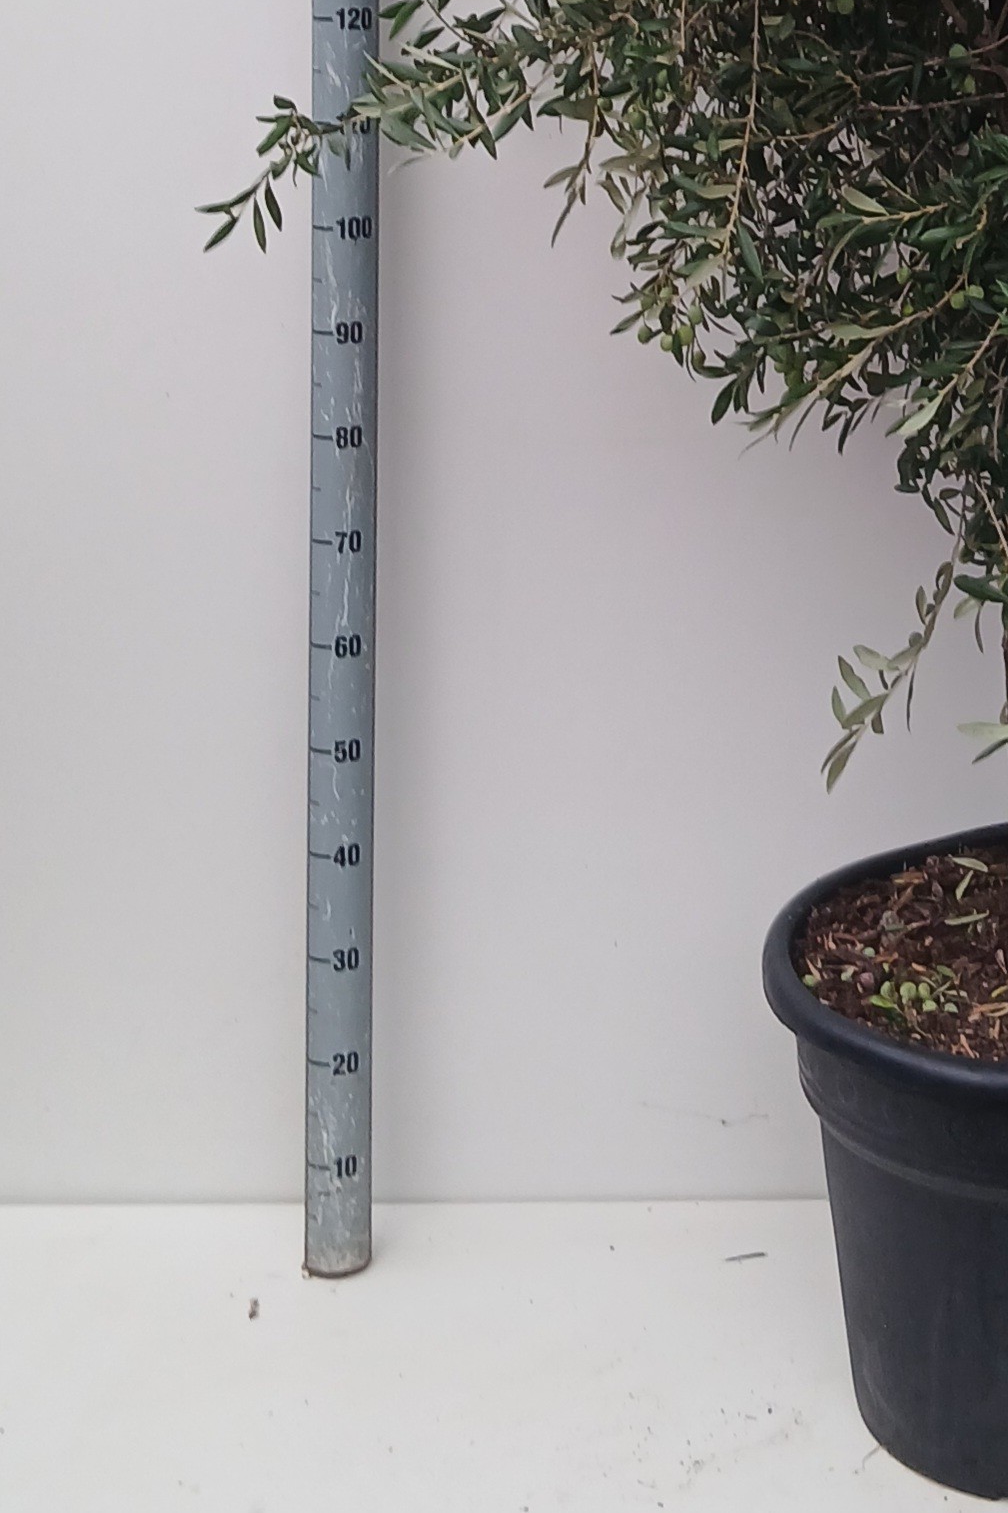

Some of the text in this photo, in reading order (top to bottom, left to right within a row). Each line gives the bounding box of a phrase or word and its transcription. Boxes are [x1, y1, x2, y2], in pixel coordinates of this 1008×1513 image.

[336, 7, 372, 30] 120
[336, 215, 372, 240] 100
[336, 321, 363, 345] 90
[336, 425, 363, 449] 80
[335, 529, 362, 554] 70
[334, 634, 362, 658] 60
[334, 739, 361, 763] 50
[333, 843, 360, 867] 40
[333, 947, 359, 972] 30
[333, 1051, 359, 1076] 20
[334, 1154, 358, 1179] 10
